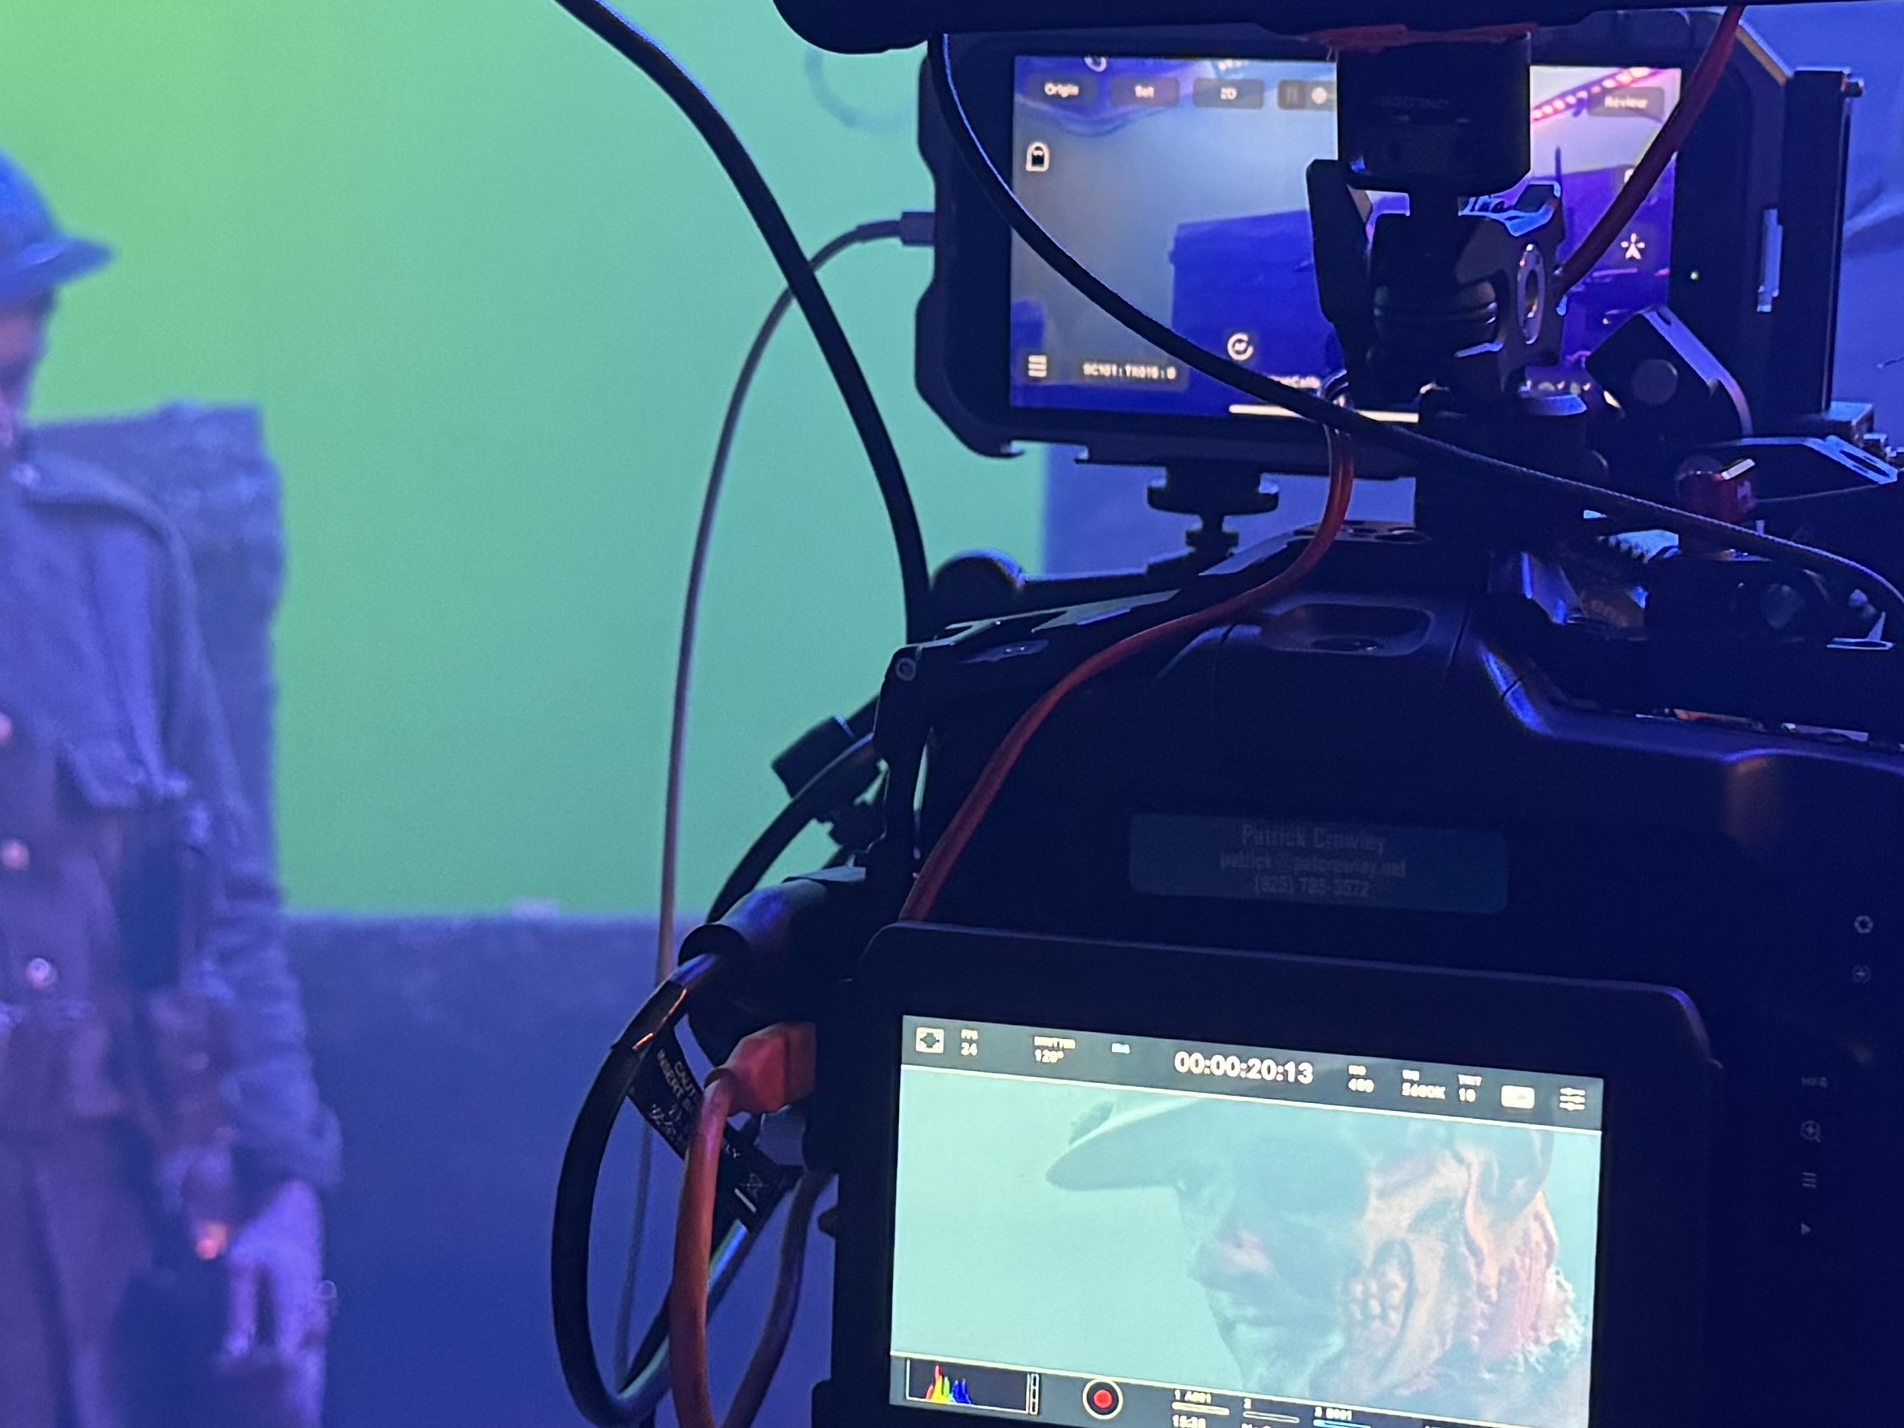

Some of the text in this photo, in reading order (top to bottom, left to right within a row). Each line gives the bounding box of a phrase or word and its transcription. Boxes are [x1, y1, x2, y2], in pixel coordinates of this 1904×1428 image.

[1241, 824, 1387, 856] Patrick Crowley
[960, 1042, 978, 1056] 24
[1174, 1051, 1313, 1085] 00:00:20:13
